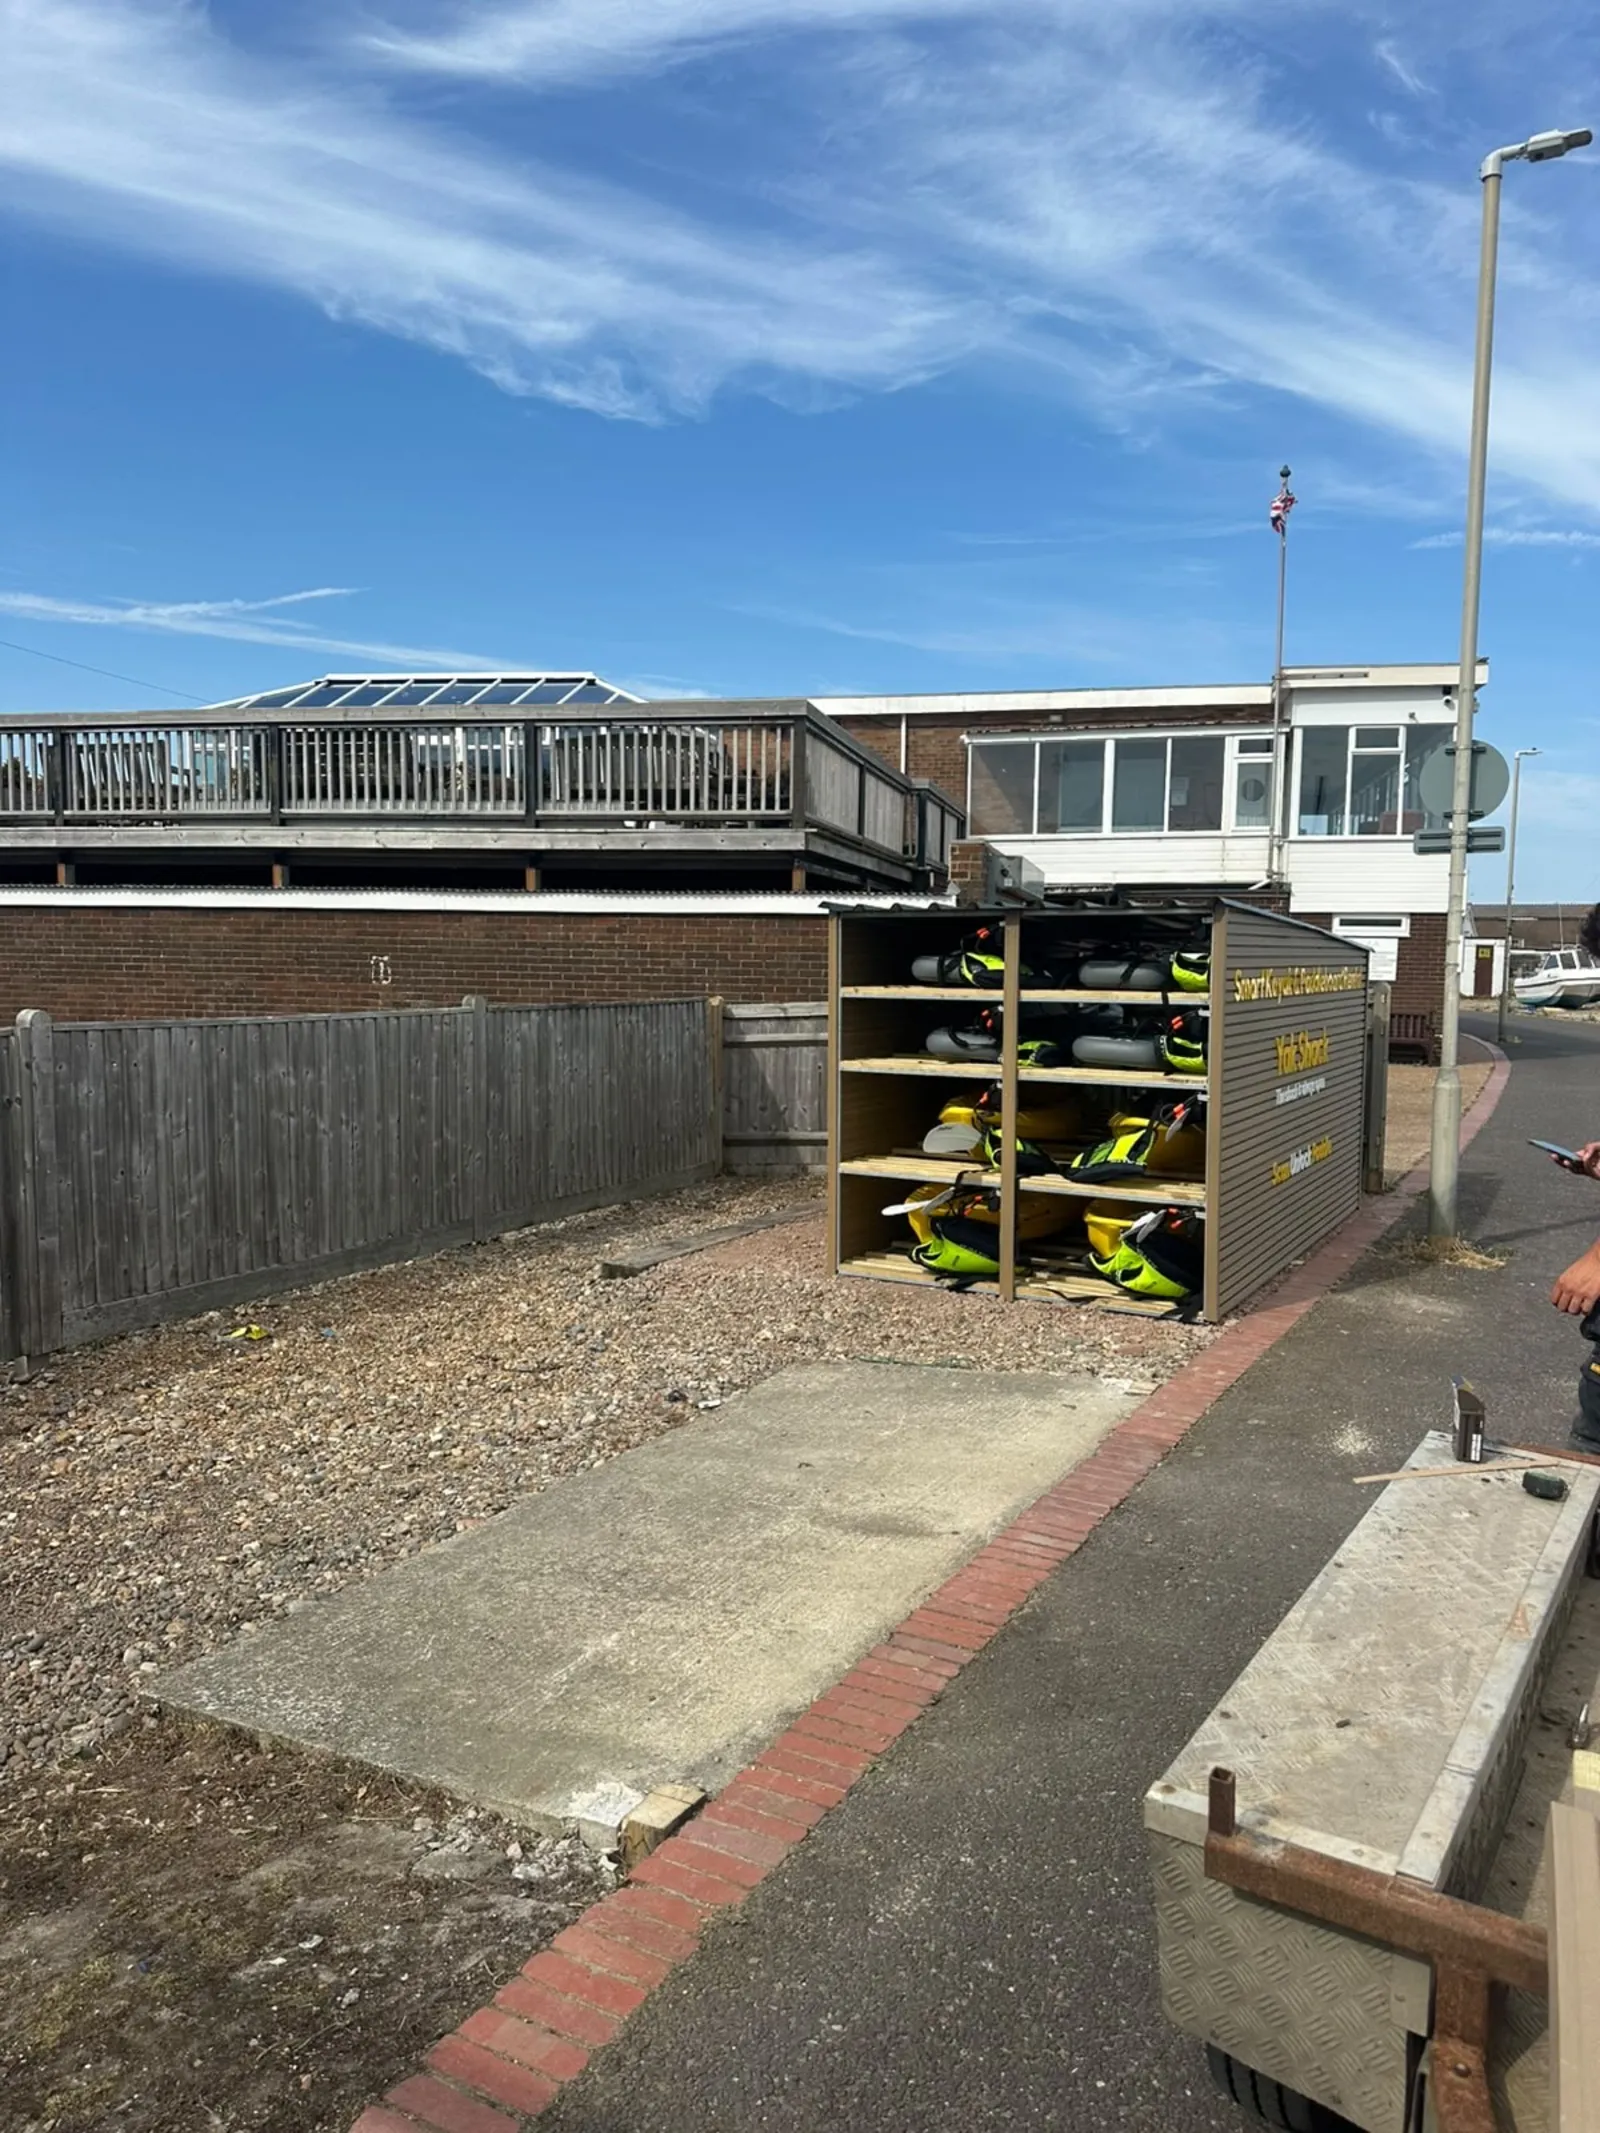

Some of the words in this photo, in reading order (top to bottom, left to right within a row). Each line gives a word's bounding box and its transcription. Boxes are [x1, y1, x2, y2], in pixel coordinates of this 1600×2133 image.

[1234, 967, 1265, 1002] Smart
[1275, 1033, 1296, 1076] Yak
[1297, 1026, 1329, 1071] Shack
